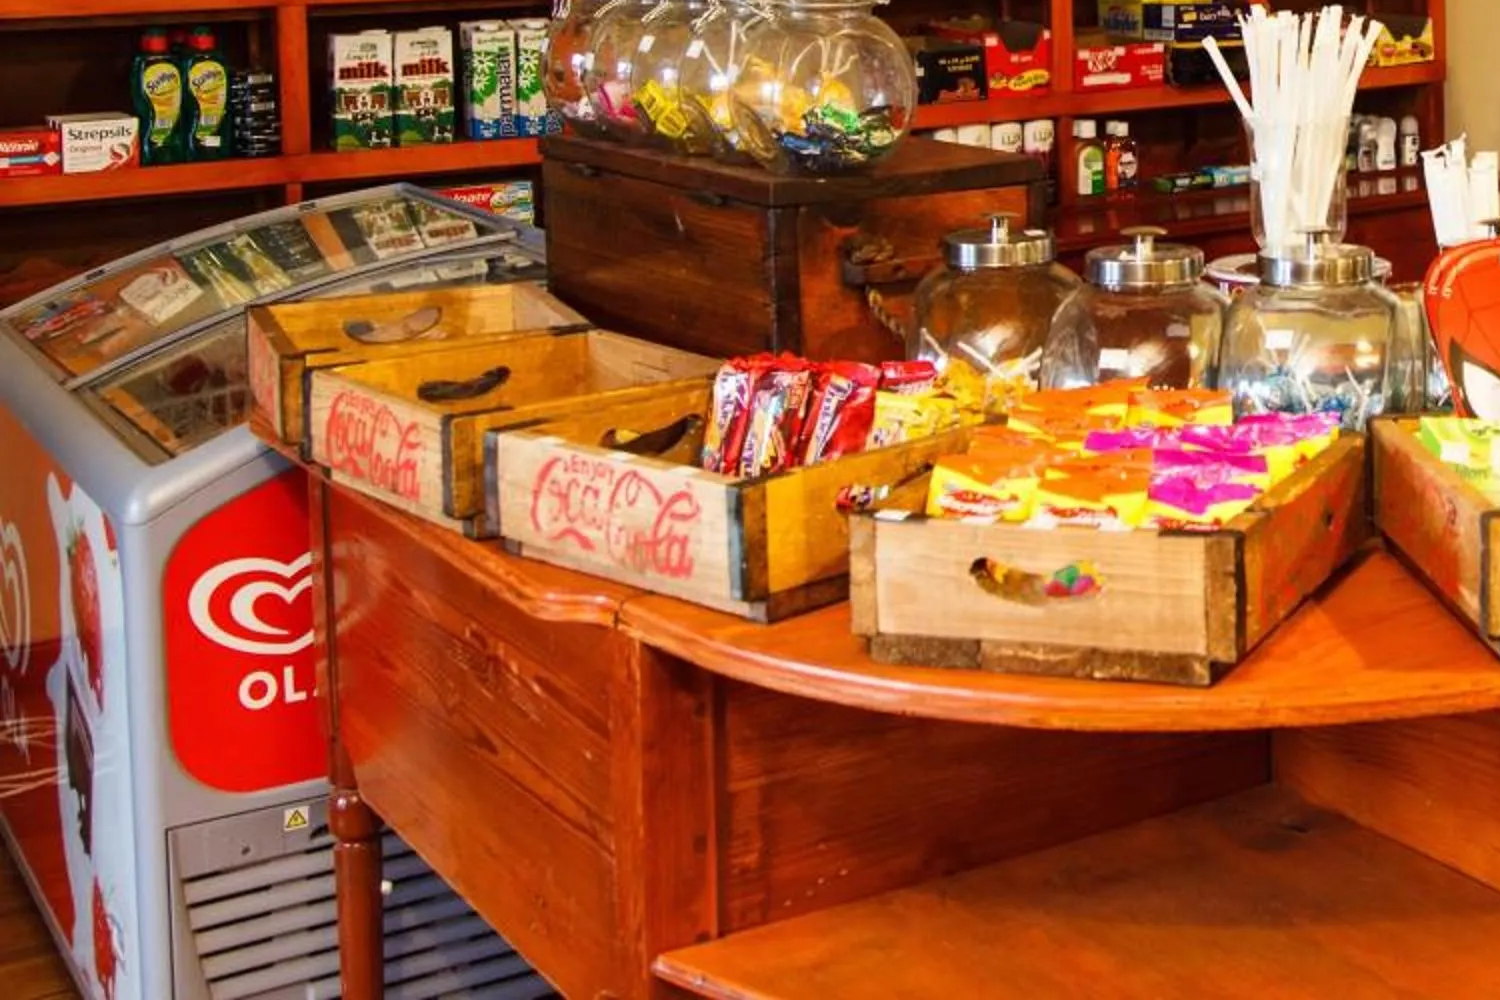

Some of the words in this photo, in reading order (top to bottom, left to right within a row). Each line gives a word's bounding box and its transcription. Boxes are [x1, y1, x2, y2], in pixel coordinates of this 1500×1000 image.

[339, 60, 389, 81] milk
[402, 57, 451, 77] milk
[67, 125, 132, 142] Strepsils
[238, 668, 316, 710] OL
